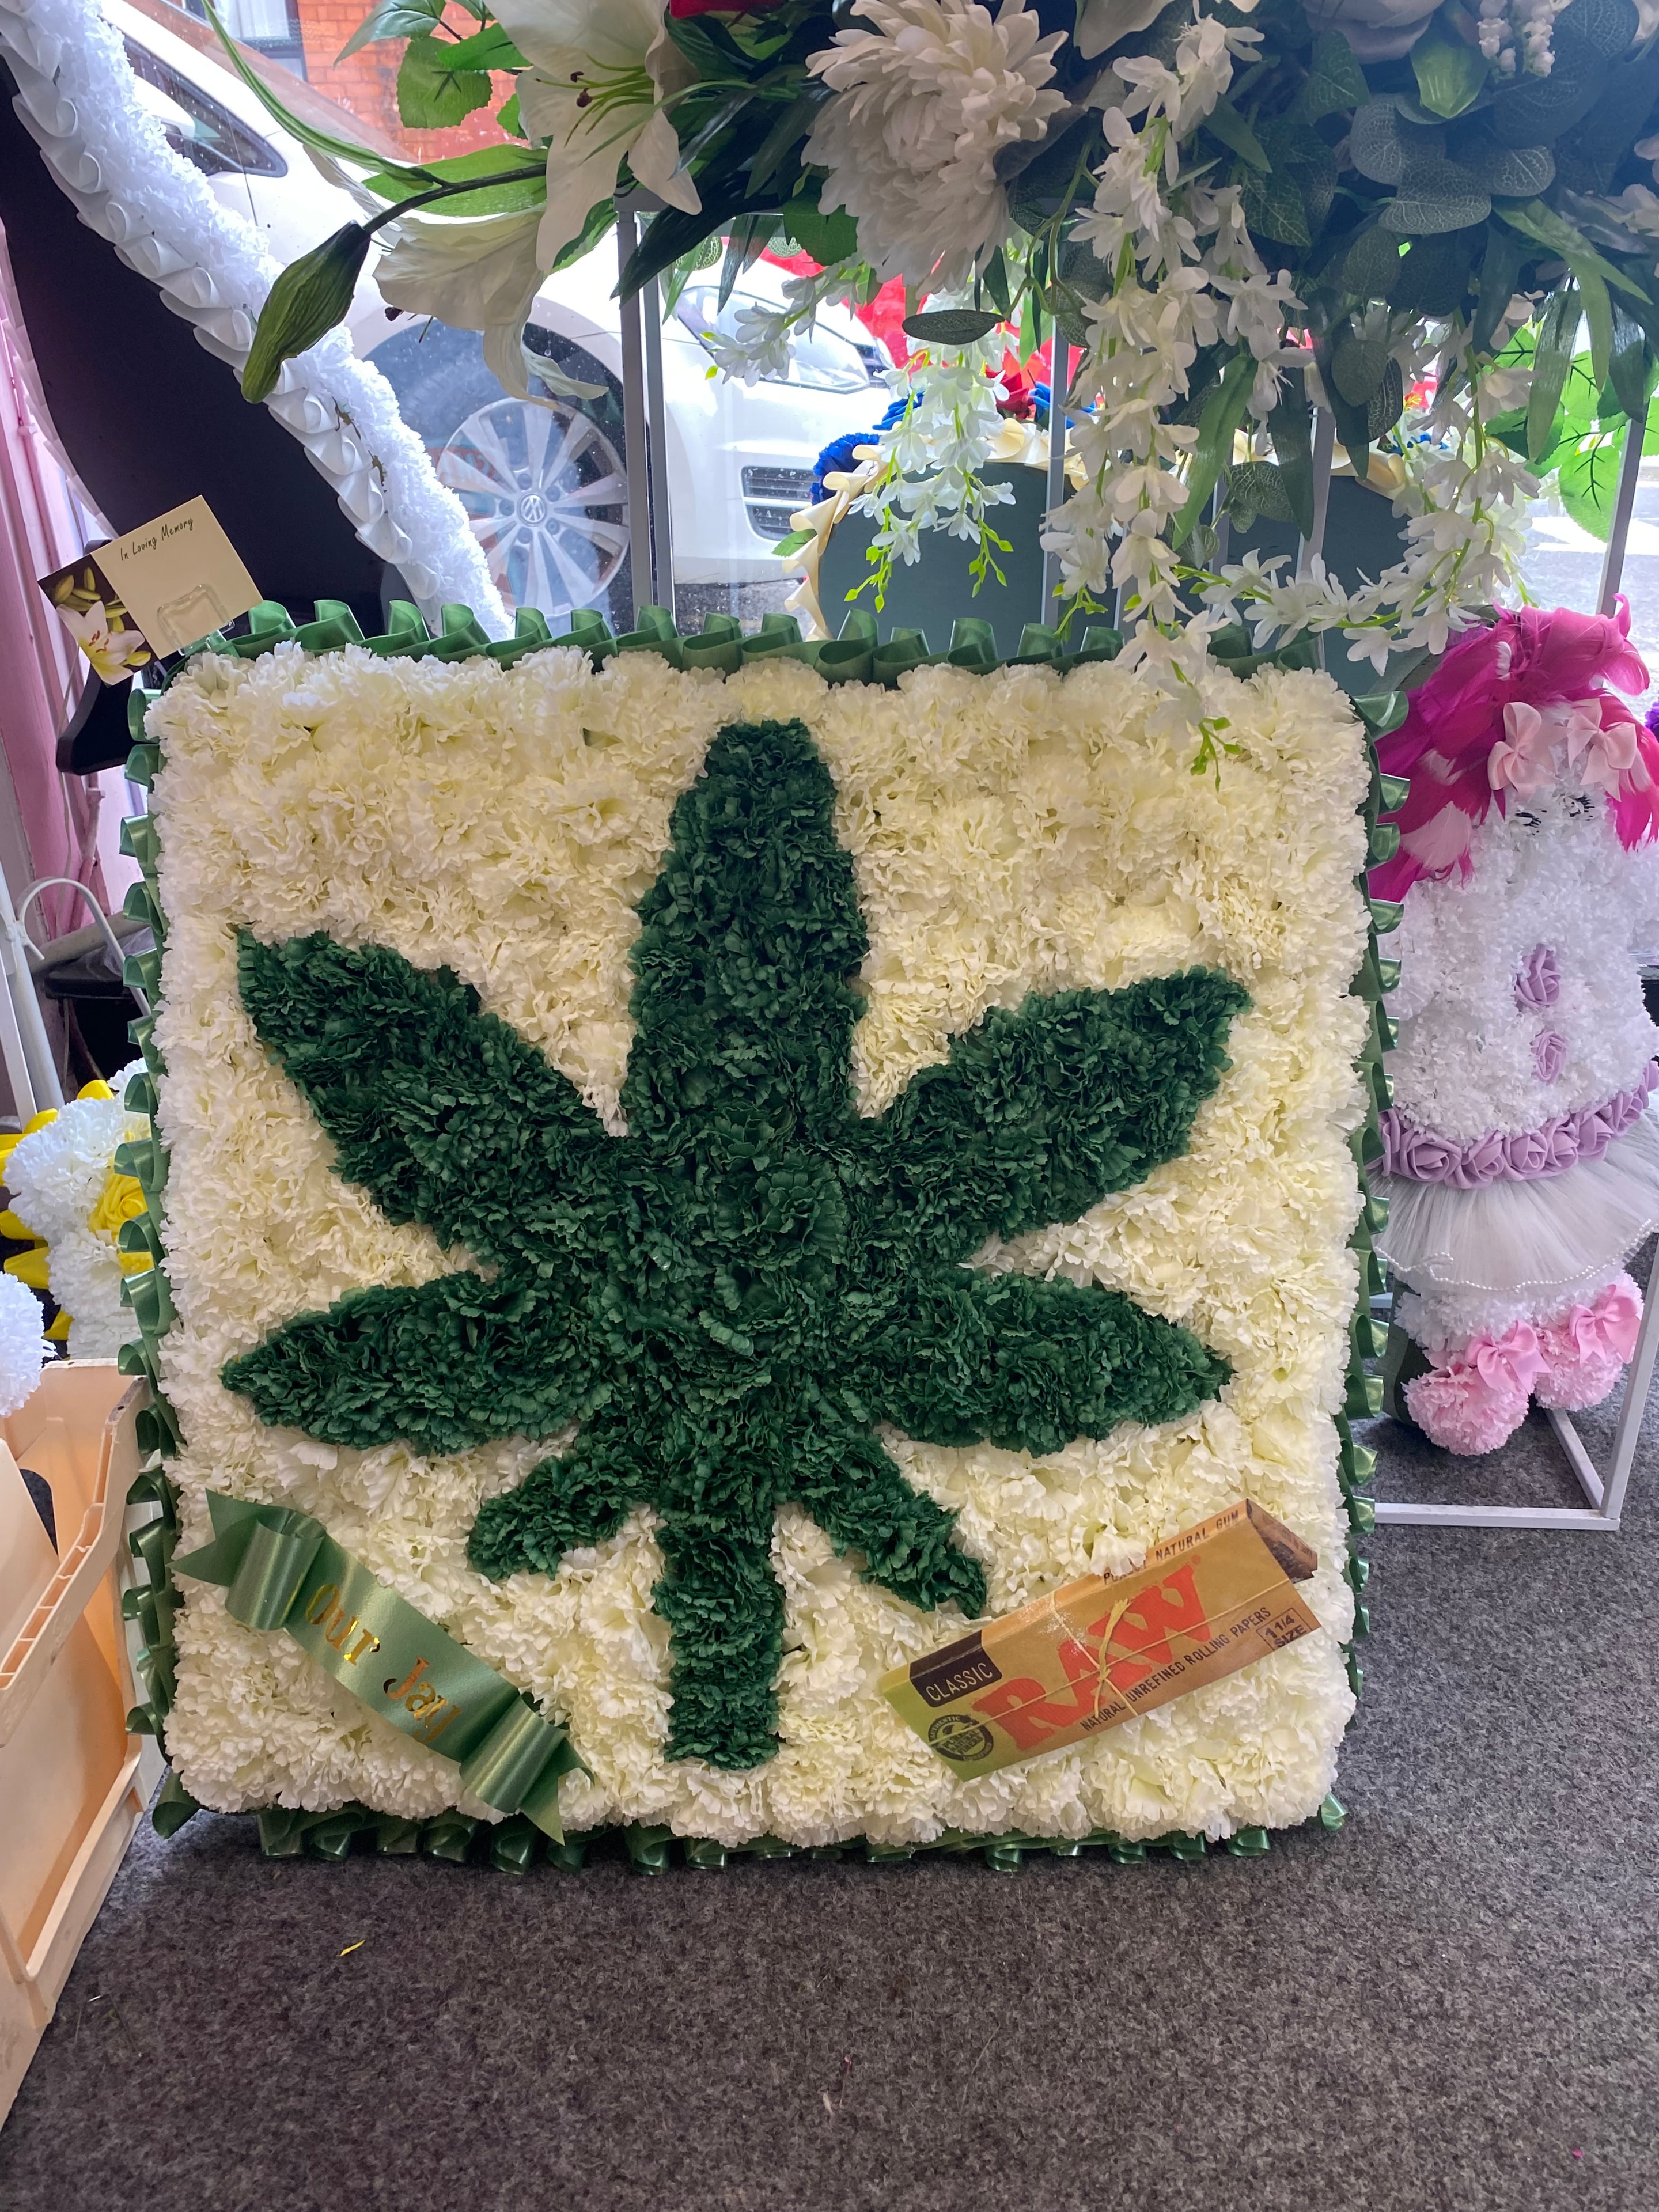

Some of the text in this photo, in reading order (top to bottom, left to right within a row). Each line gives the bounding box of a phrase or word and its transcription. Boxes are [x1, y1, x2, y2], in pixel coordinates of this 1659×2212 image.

[120, 518, 194, 561] In Loving Memory
[1155, 1527, 1210, 1561] NATURAL
[1215, 1510, 1239, 1530] GUM
[972, 1563, 1210, 1751] RAW
[1273, 1624, 1308, 1649] SIZE
[925, 1662, 993, 1702] CLASSIC
[1080, 1607, 1271, 1732] NATURAL UNREFINED ROLLING PAPERS
[382, 1656, 461, 1743] Jay
